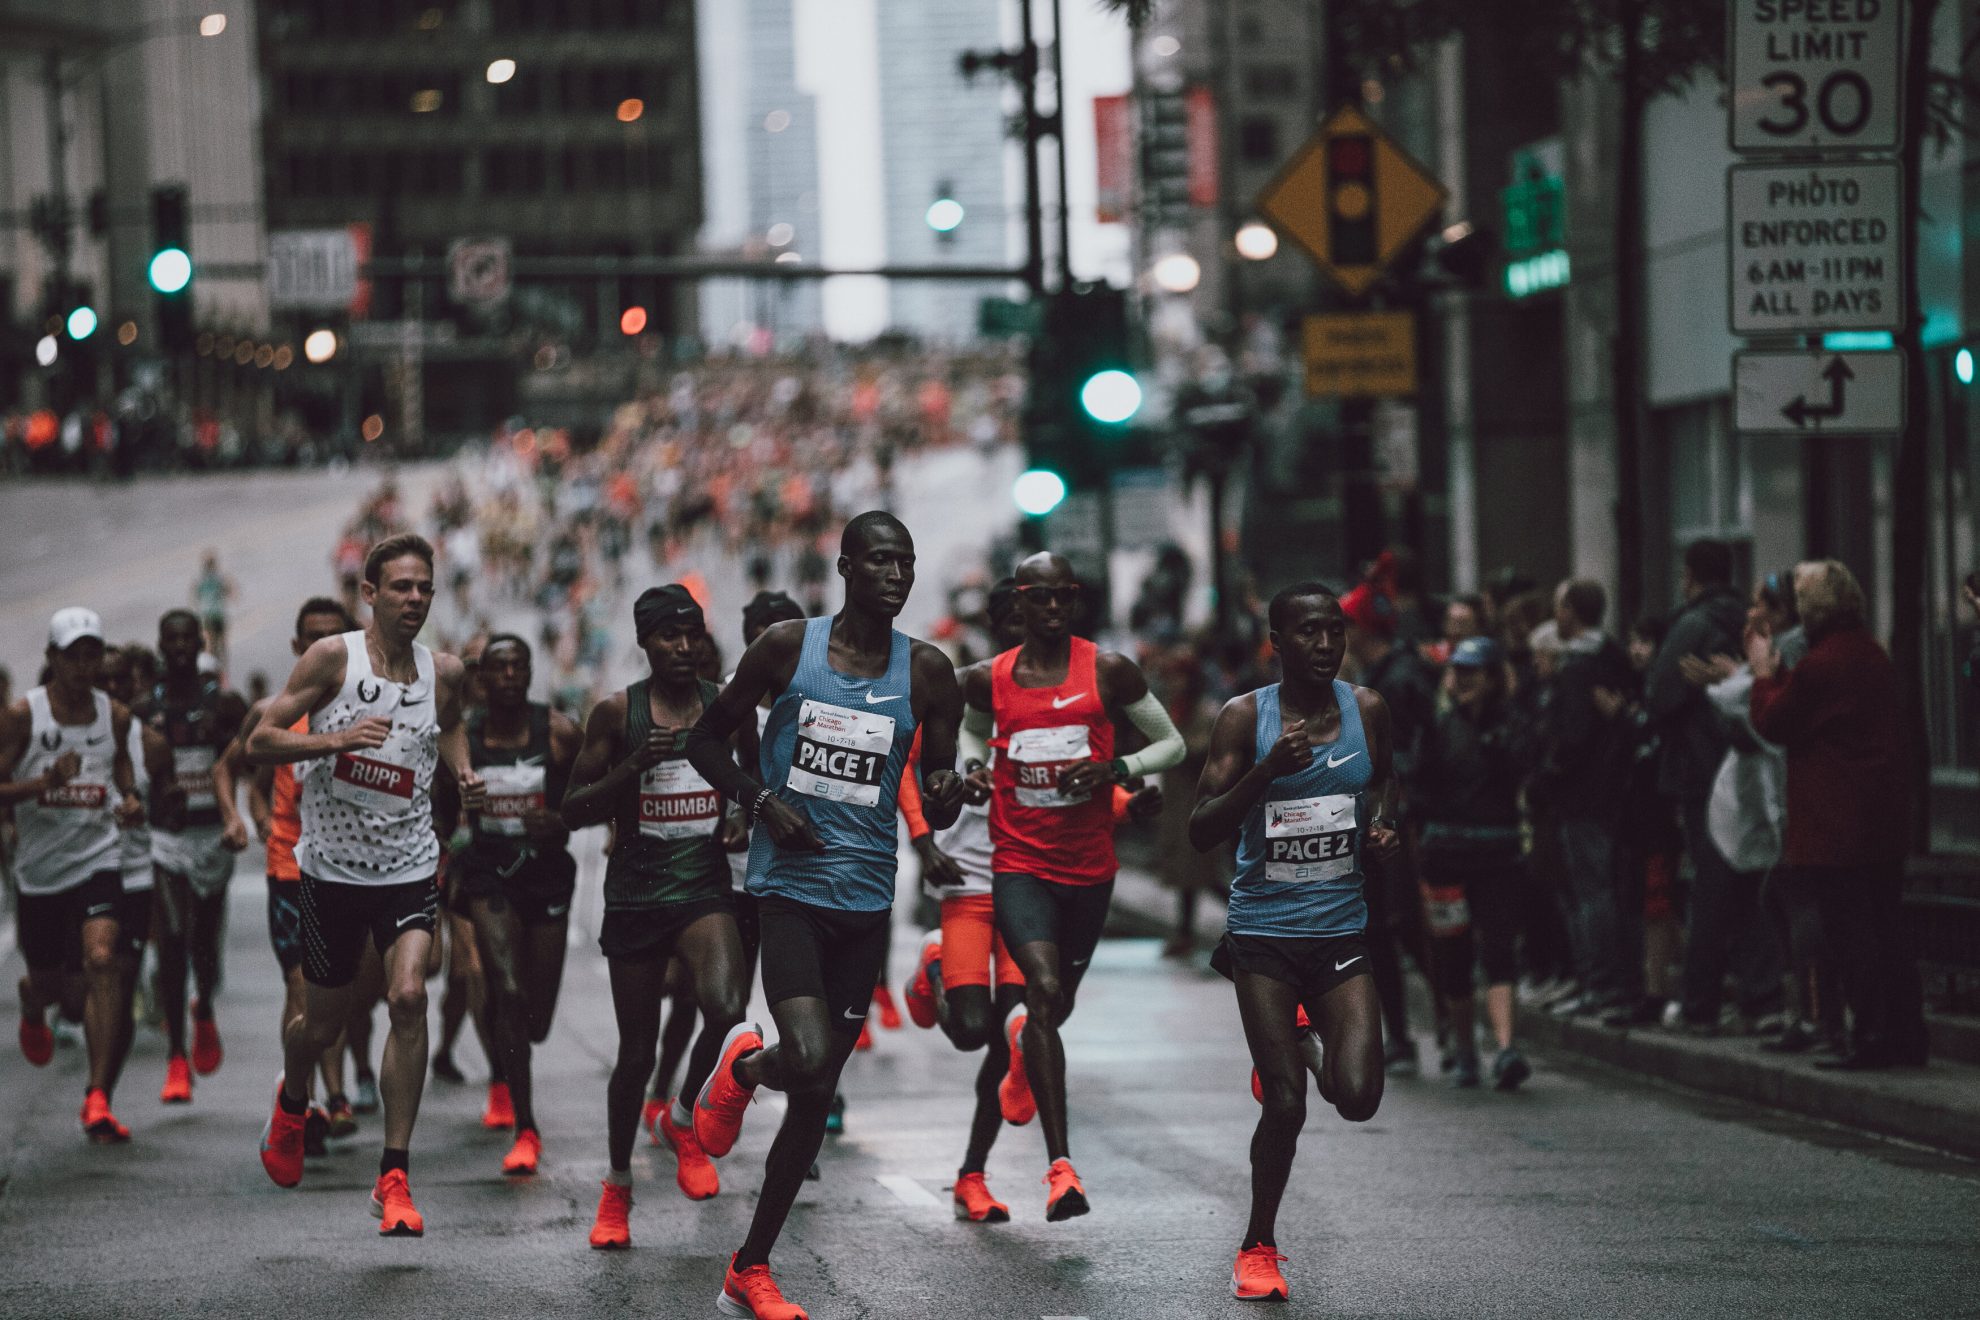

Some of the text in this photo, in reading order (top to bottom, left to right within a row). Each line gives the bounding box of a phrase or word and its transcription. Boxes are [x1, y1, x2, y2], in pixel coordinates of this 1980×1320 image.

[1754, 0, 1881, 23] SPEED
[1767, 32, 1867, 60] LIMIT
[1757, 70, 1873, 136] 30
[1769, 179, 1859, 206] PHOTO
[1743, 218, 1886, 247] ENFORCED
[1751, 288, 1882, 316] ALL DAYS
[816, 722, 846, 732] Marathon
[819, 715, 842, 725] Chicago
[799, 741, 876, 781] PACE 1
[350, 761, 401, 789] RUPP
[1020, 766, 1050, 785] SIR
[643, 796, 717, 816] CHUMBA
[1273, 834, 1349, 860] PACE 2
